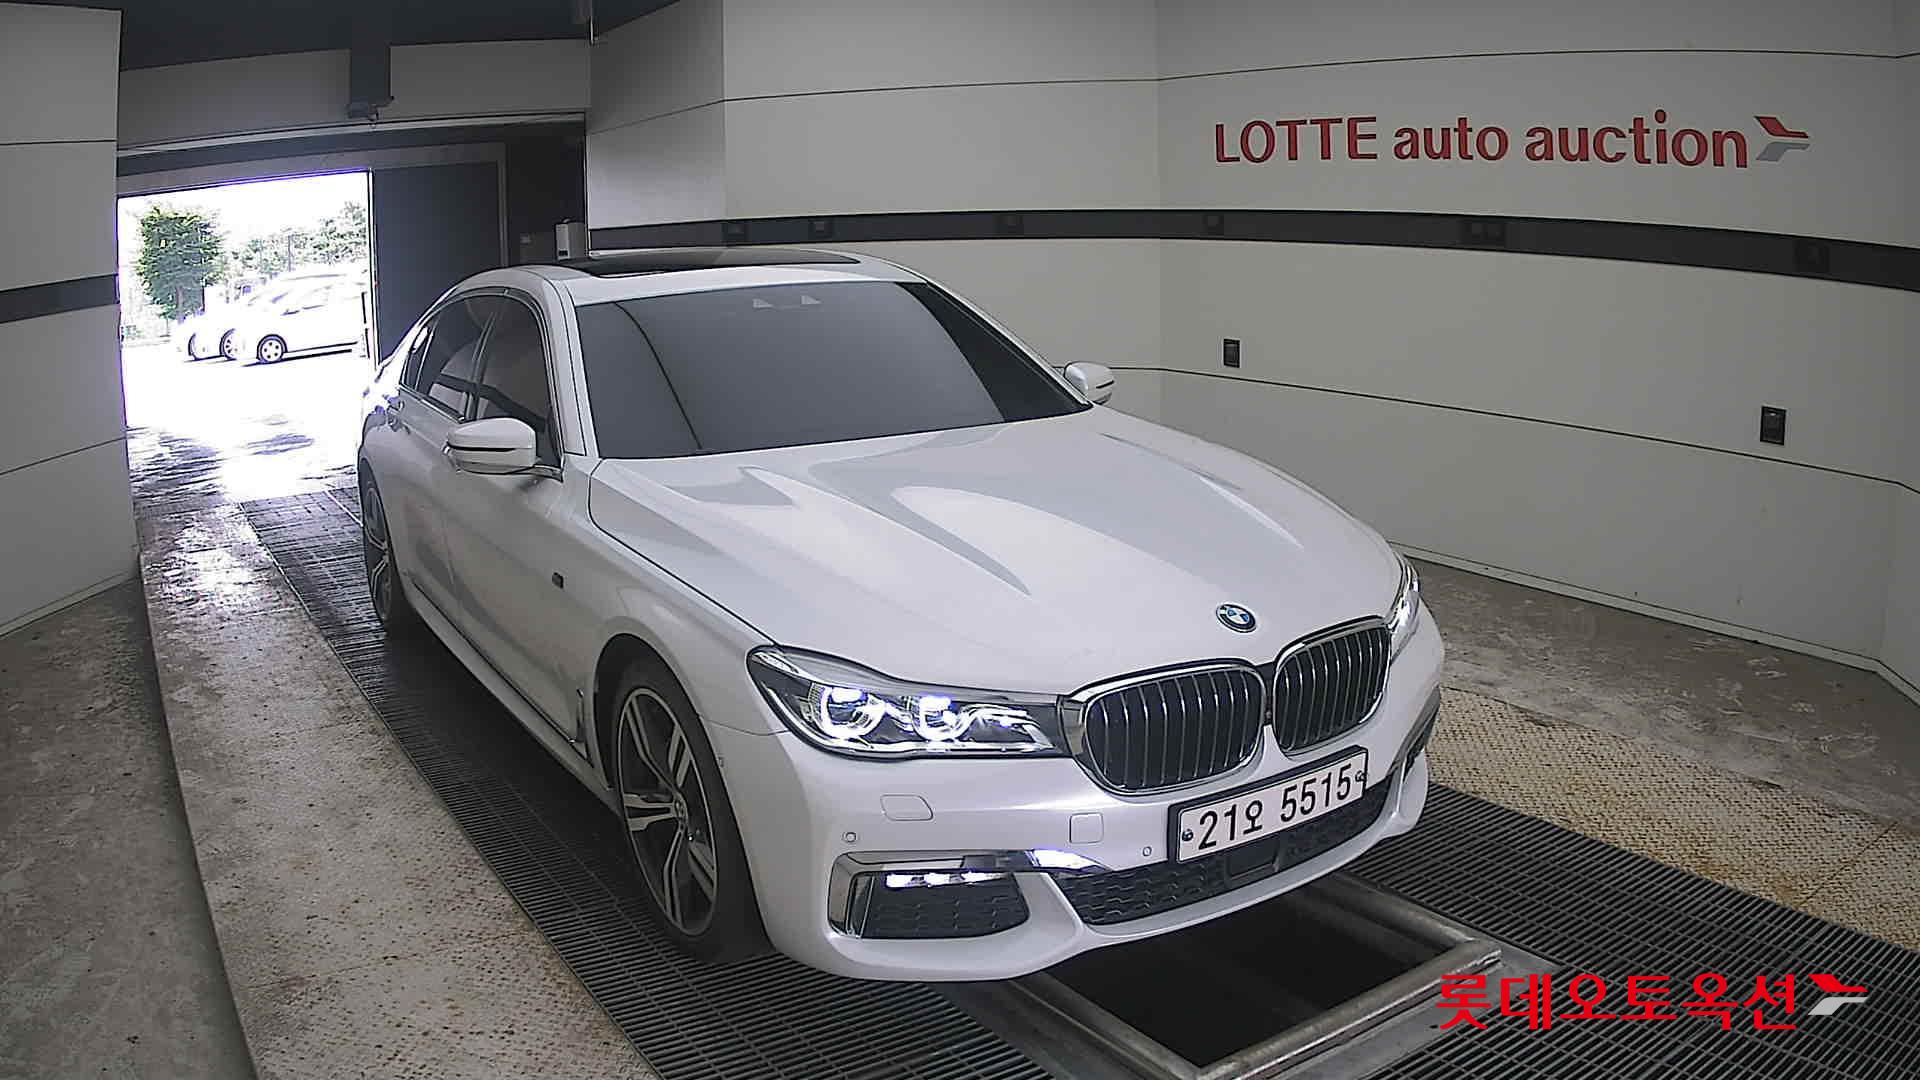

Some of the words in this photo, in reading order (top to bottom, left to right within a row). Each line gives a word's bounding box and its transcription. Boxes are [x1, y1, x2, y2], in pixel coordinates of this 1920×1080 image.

[1215, 116, 1378, 163] LOTTE
[1393, 117, 1509, 162] auto
[1525, 109, 1749, 169] auction
[1198, 800, 1263, 850] 21오
[1280, 763, 1352, 823] 5515
